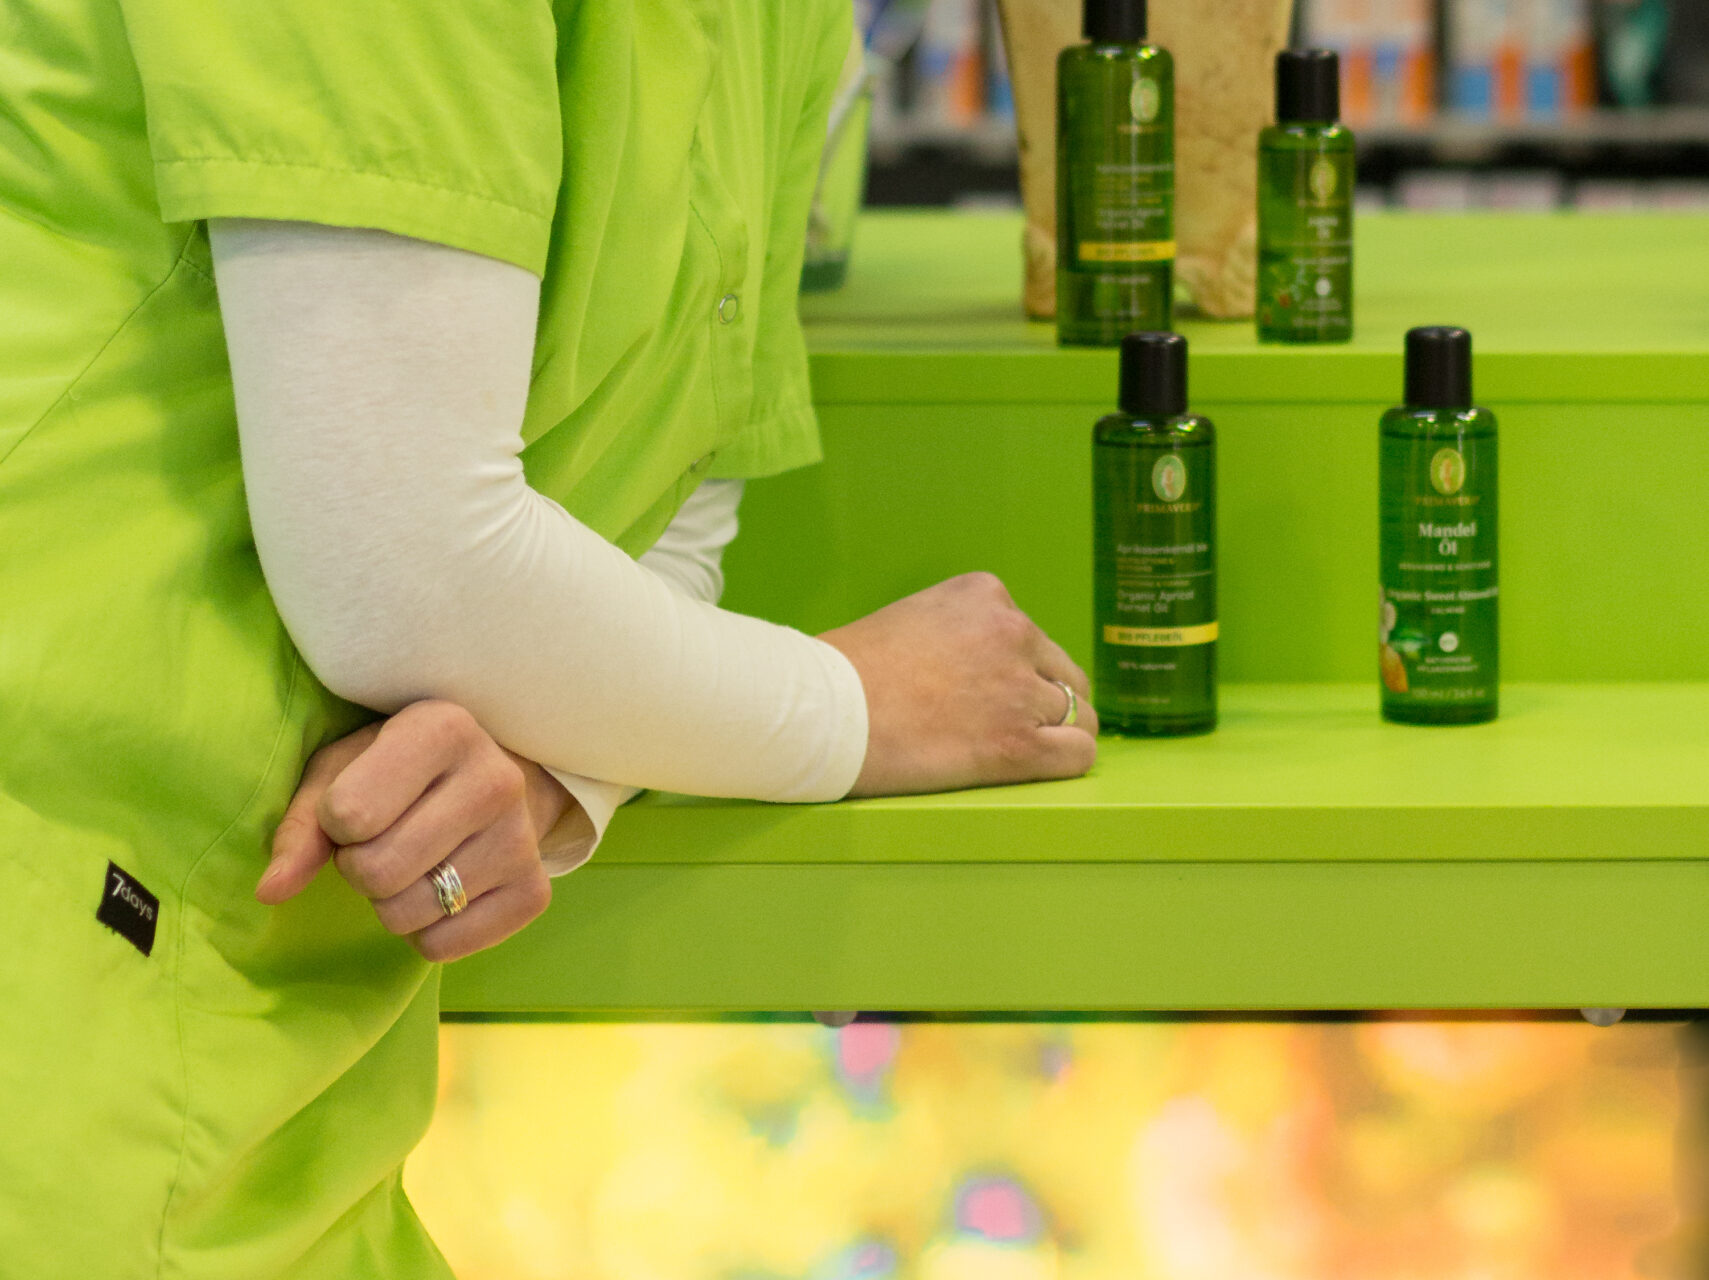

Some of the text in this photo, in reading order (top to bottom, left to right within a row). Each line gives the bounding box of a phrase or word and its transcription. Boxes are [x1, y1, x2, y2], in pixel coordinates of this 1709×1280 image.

[1418, 522, 1477, 538] Mandel
[1438, 537, 1457, 556] Öl
[112, 872, 153, 921] 7days
